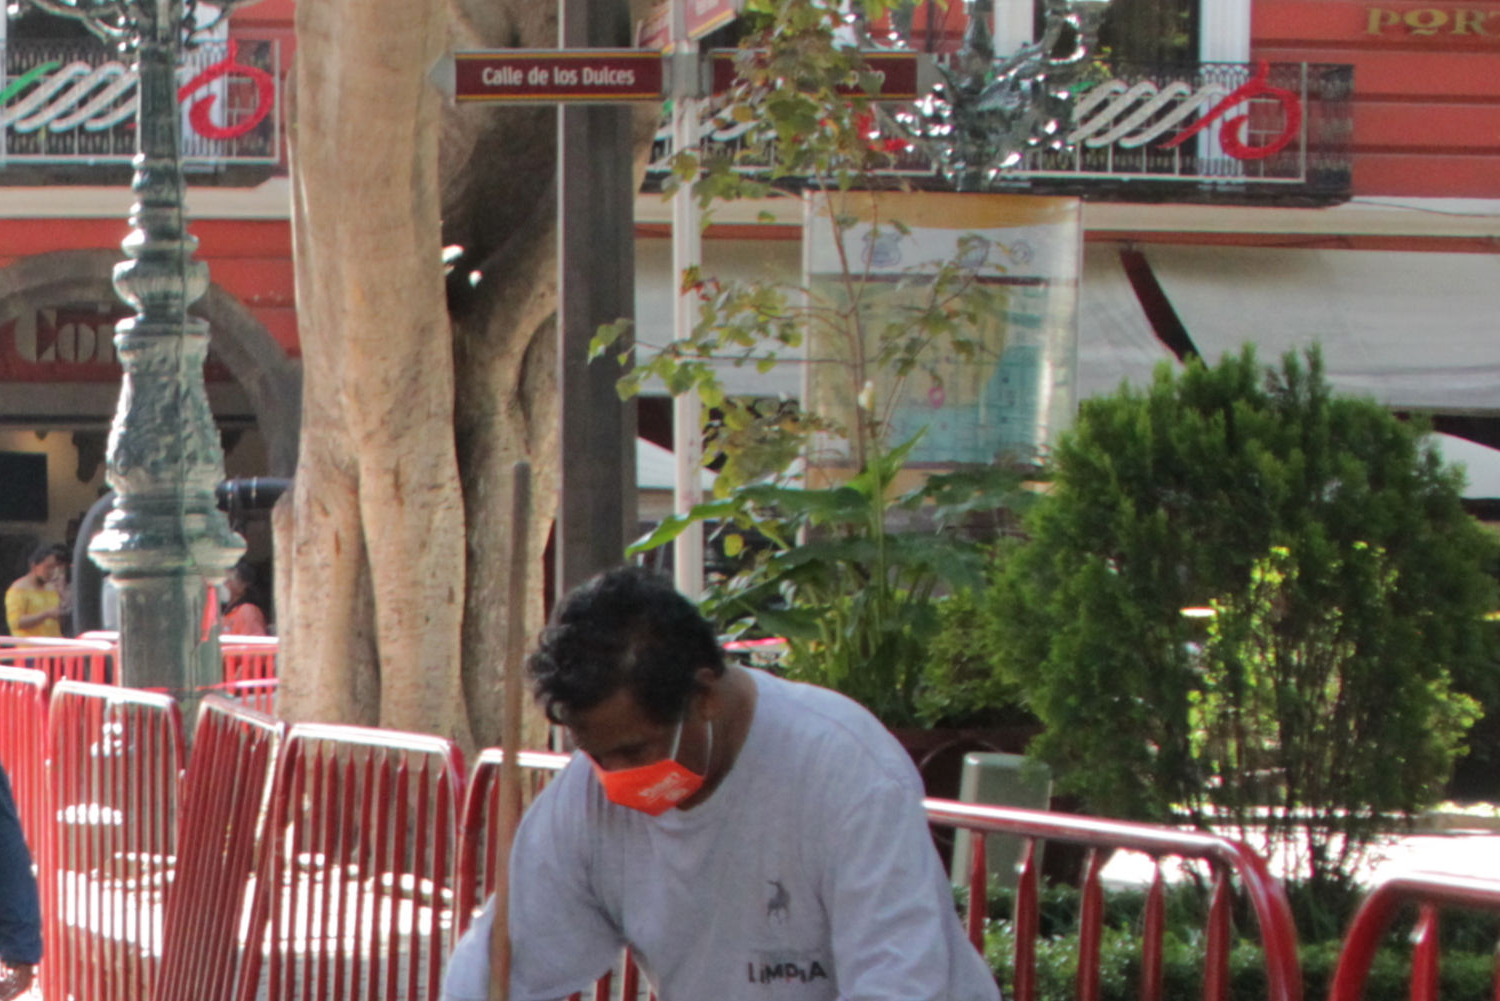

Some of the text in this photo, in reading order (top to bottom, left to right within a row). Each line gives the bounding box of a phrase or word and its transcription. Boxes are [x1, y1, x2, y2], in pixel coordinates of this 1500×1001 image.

[482, 66, 635, 86] Calle de los Dulces
